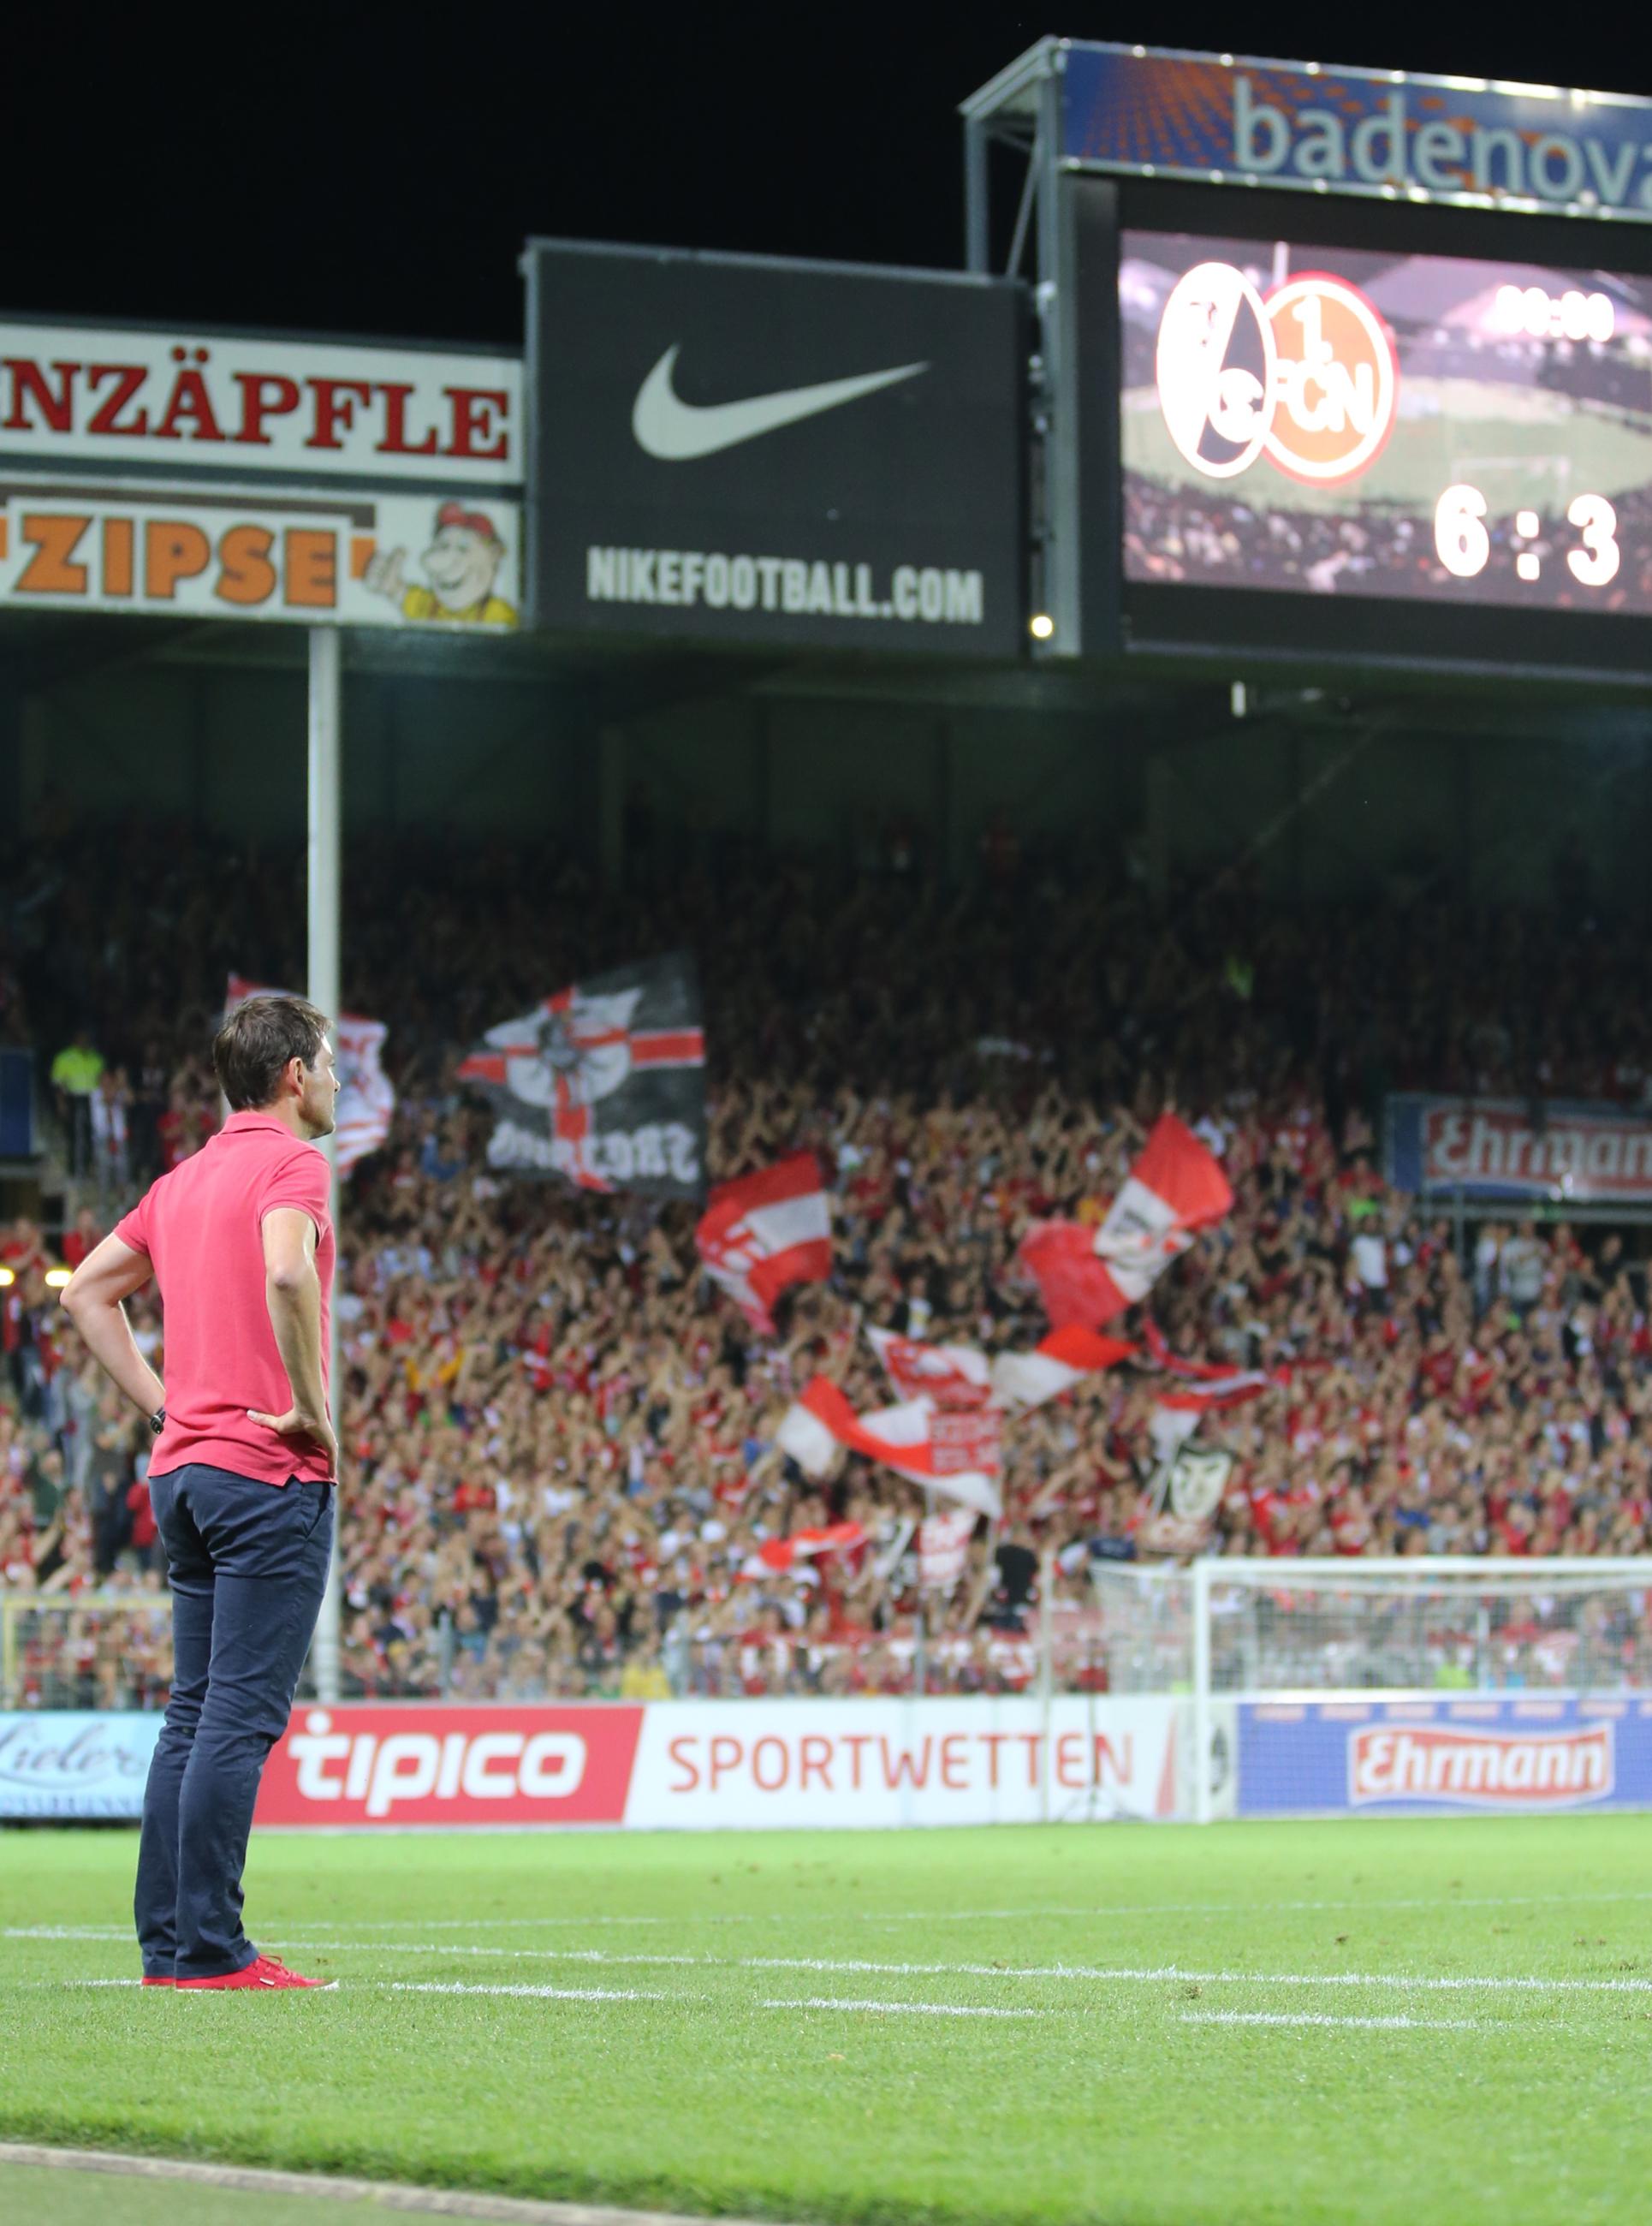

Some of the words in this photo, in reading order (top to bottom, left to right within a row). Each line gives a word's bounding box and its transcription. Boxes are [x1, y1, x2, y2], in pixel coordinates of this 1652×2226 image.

[1233, 75, 1652, 207] badenov
[2, 346, 508, 461] NZÄPFLE
[14, 513, 336, 609] ZIPSE
[587, 545, 983, 623] NIKEFOOTBALL.COM
[1435, 484, 1489, 577] 6
[1567, 494, 1620, 586] 3
[288, 1711, 587, 1818] tipico
[668, 1733, 1133, 1794] SPORTWETTEN
[1358, 1735, 1603, 1790] Ehrmann
